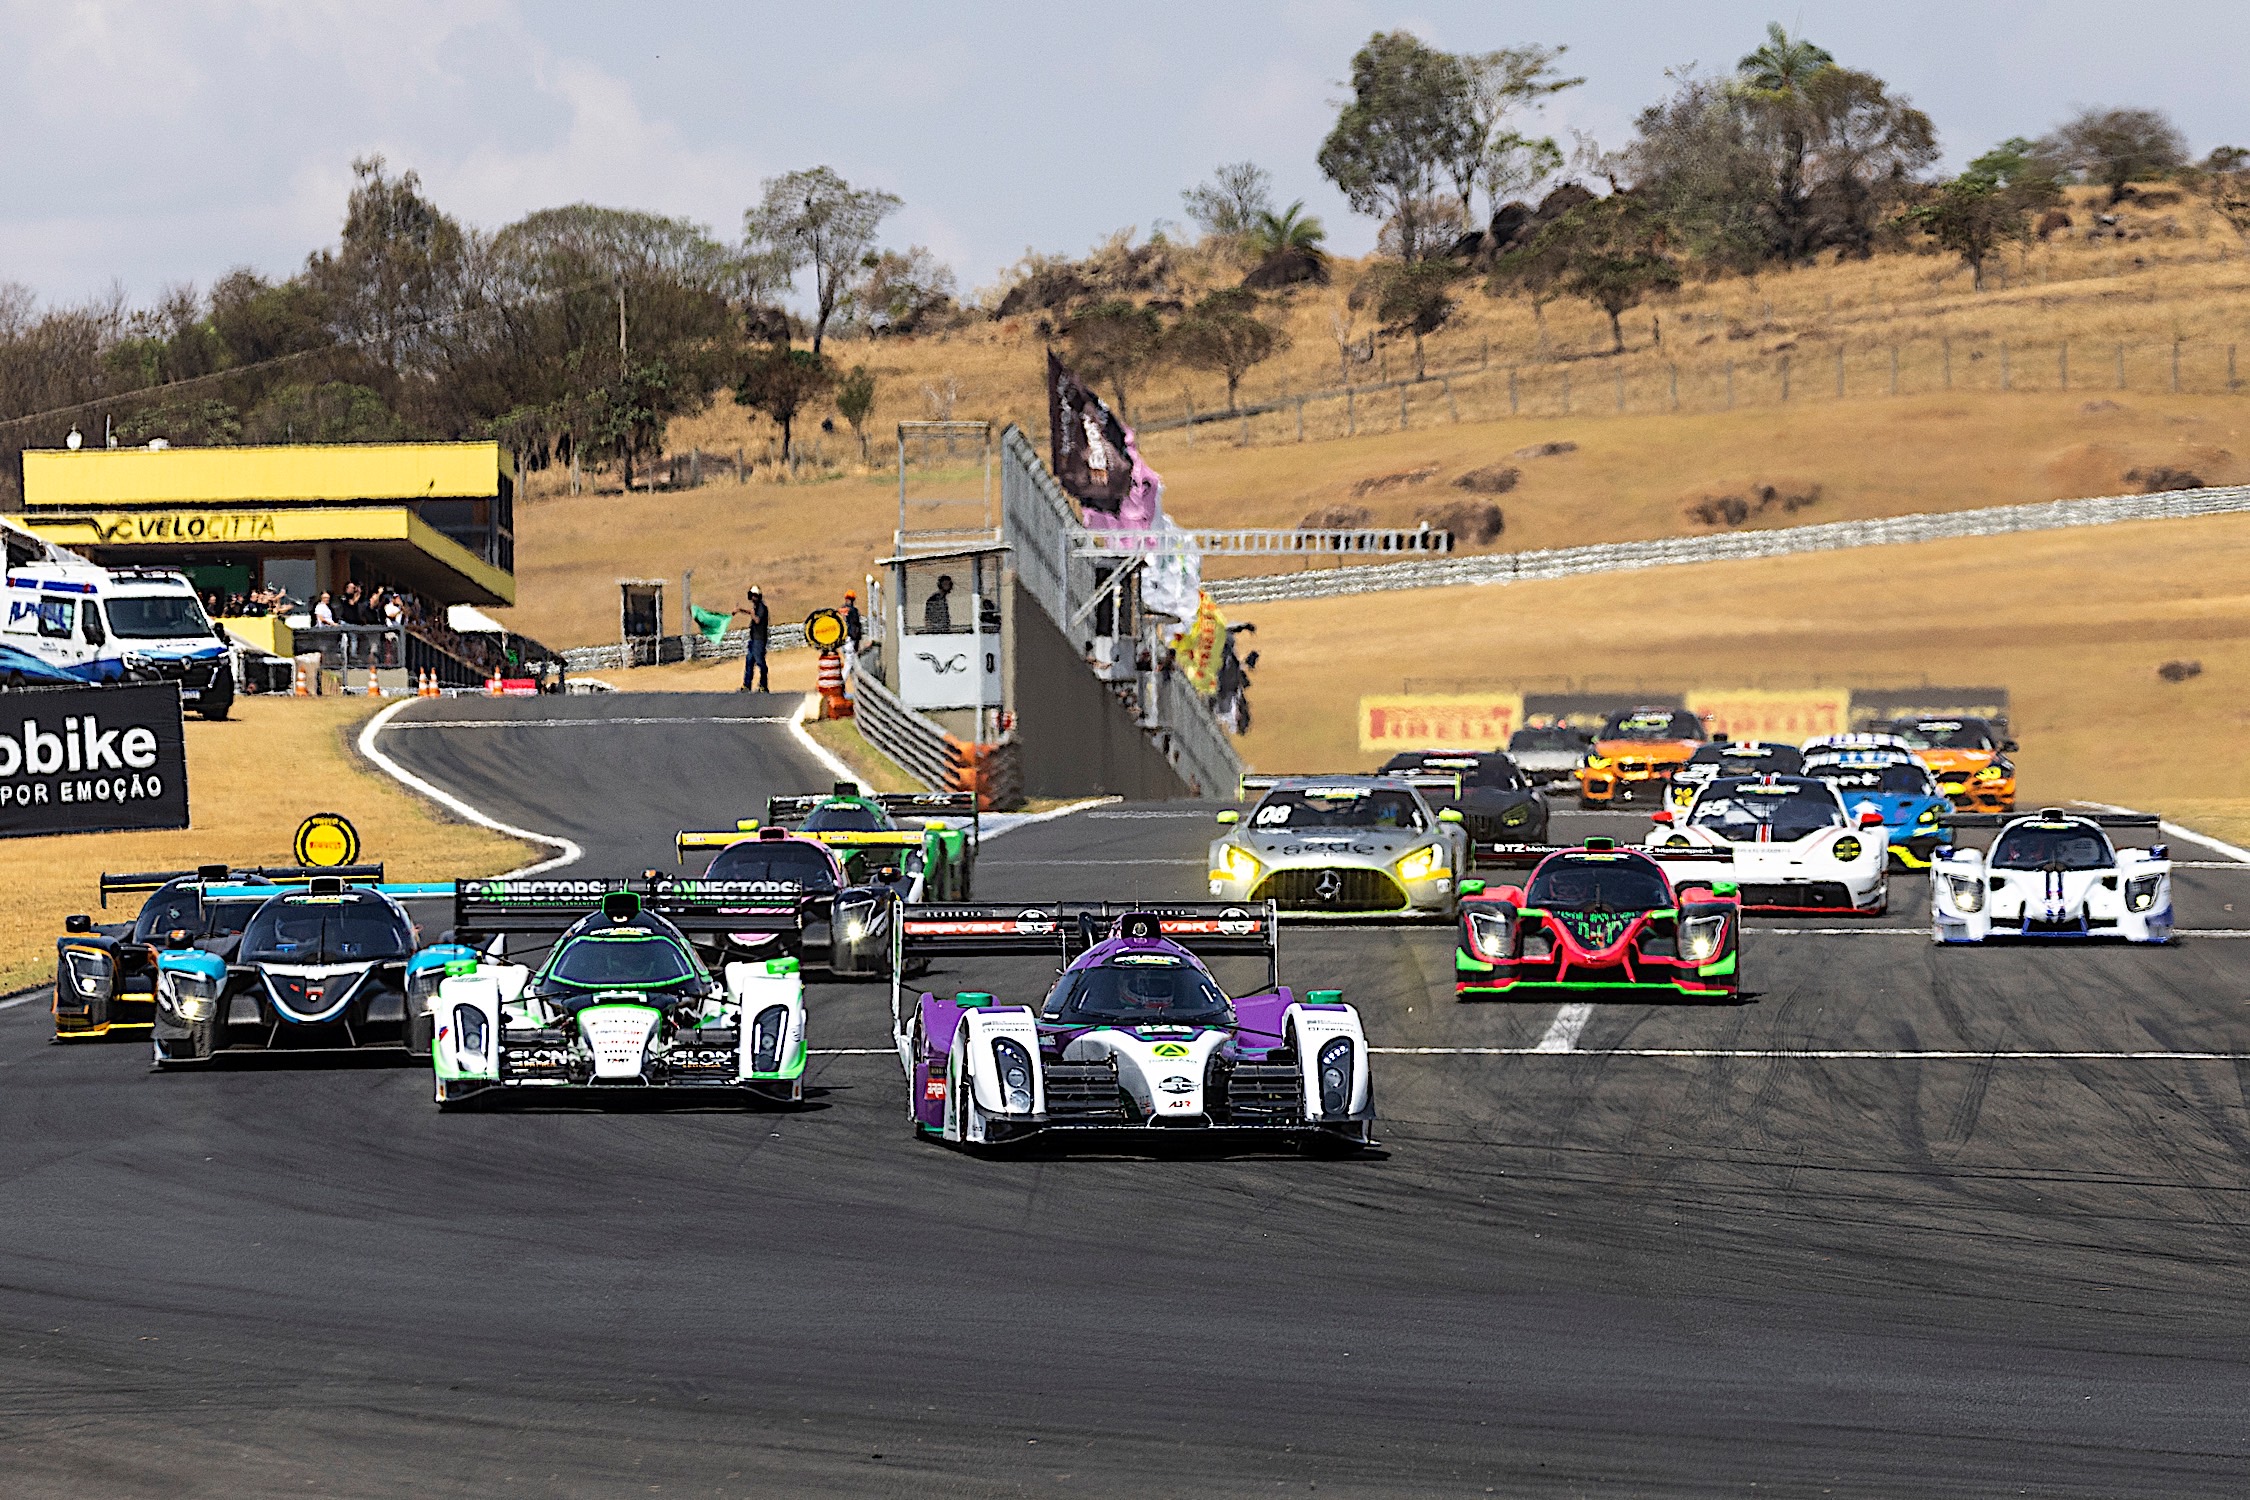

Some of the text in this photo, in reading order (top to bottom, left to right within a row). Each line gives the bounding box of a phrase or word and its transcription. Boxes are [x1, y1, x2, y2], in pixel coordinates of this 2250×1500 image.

[0, 773, 162, 806] POR EMOÇÃO
[1256, 805, 1292, 825] 08
[1494, 843, 1526, 853] BTZ
